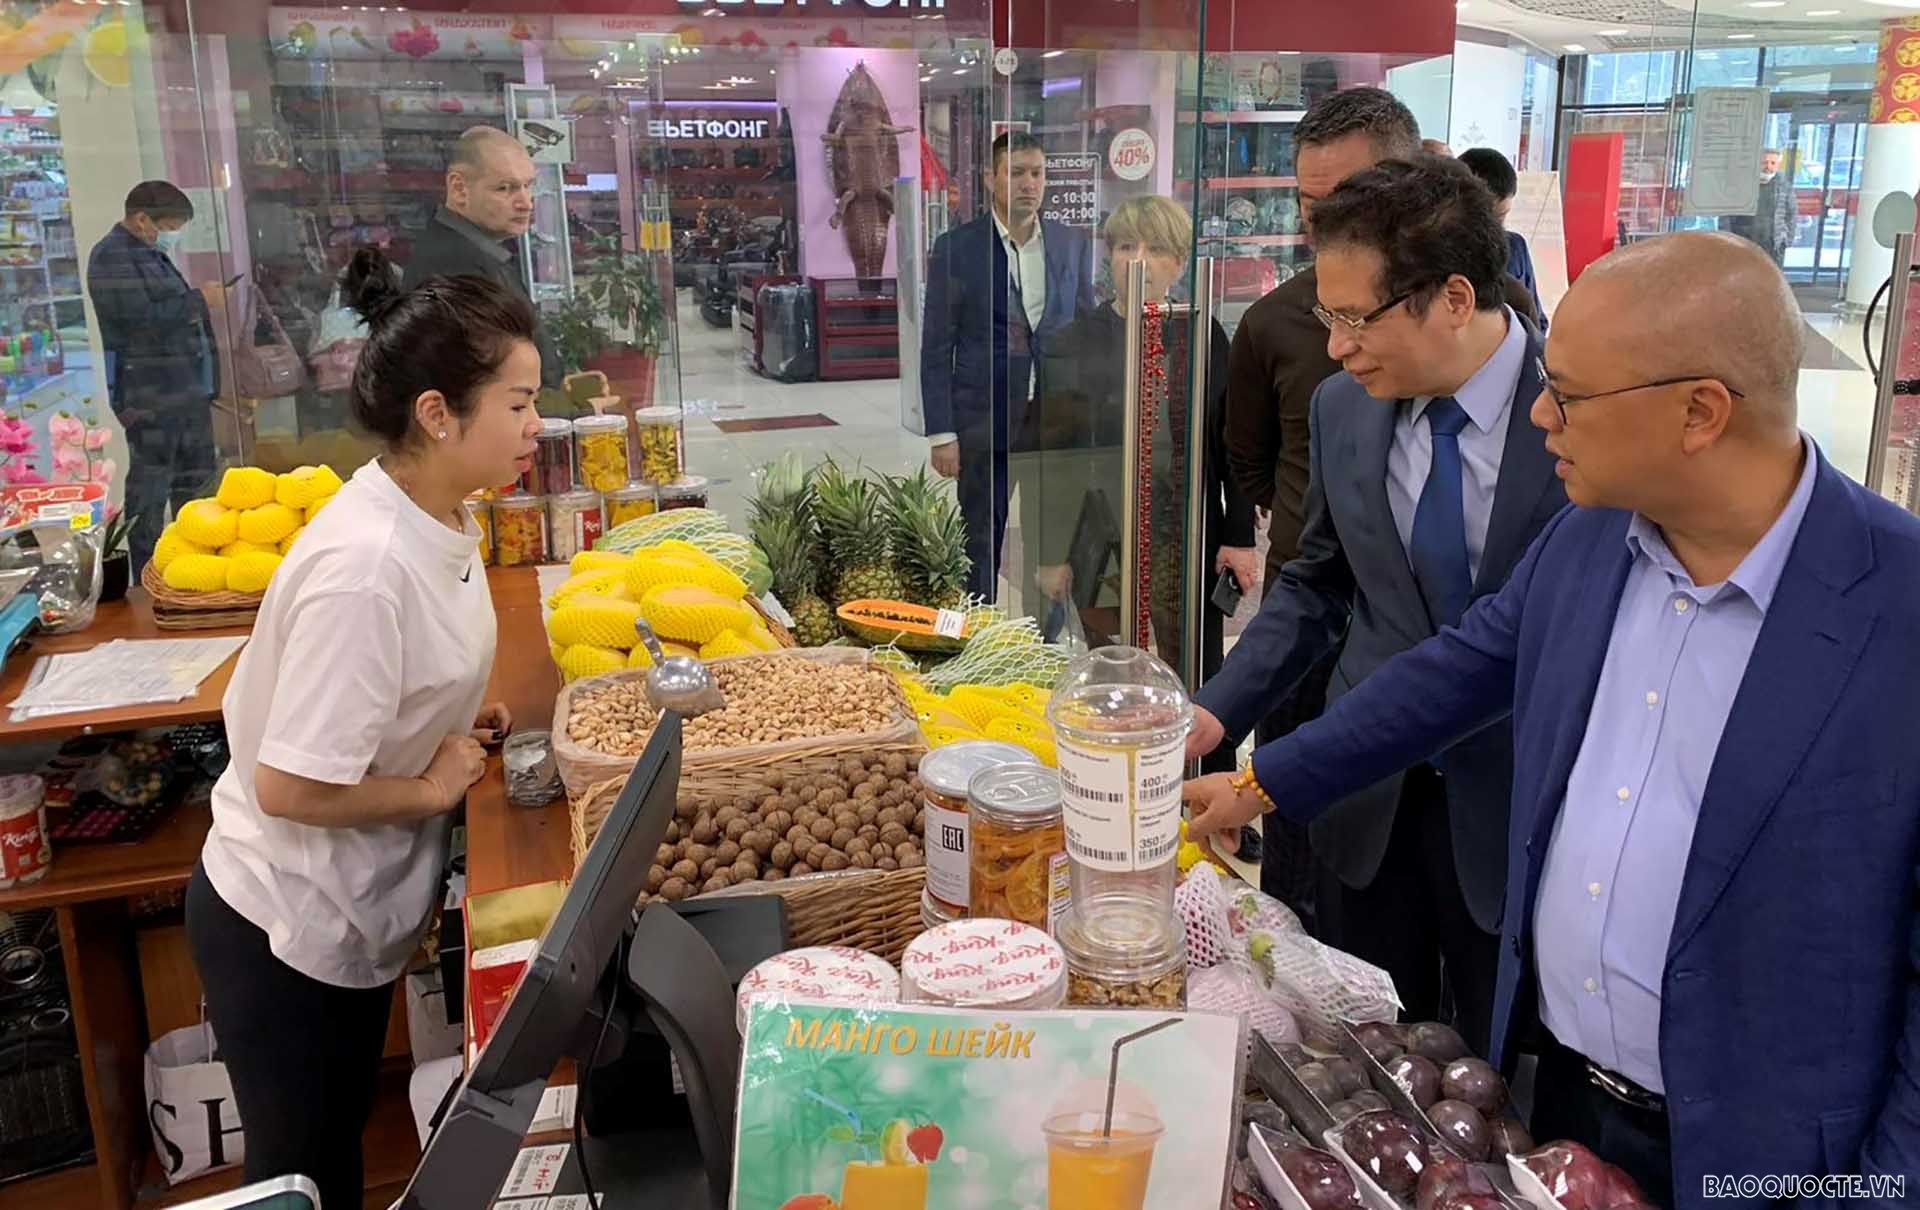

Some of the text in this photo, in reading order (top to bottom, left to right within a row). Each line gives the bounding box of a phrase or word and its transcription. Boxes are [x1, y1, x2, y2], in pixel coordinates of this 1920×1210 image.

[1114, 147, 1150, 167] 40%
[1046, 158, 1095, 169] ЬЕТФОНГ
[1063, 192, 1095, 204] 10:00
[1061, 208, 1095, 220] 21:00
[1140, 776, 1161, 788] 400
[1139, 836, 1159, 849] 350
[785, 1018, 1036, 1058] МАНГО ШЕЙК
